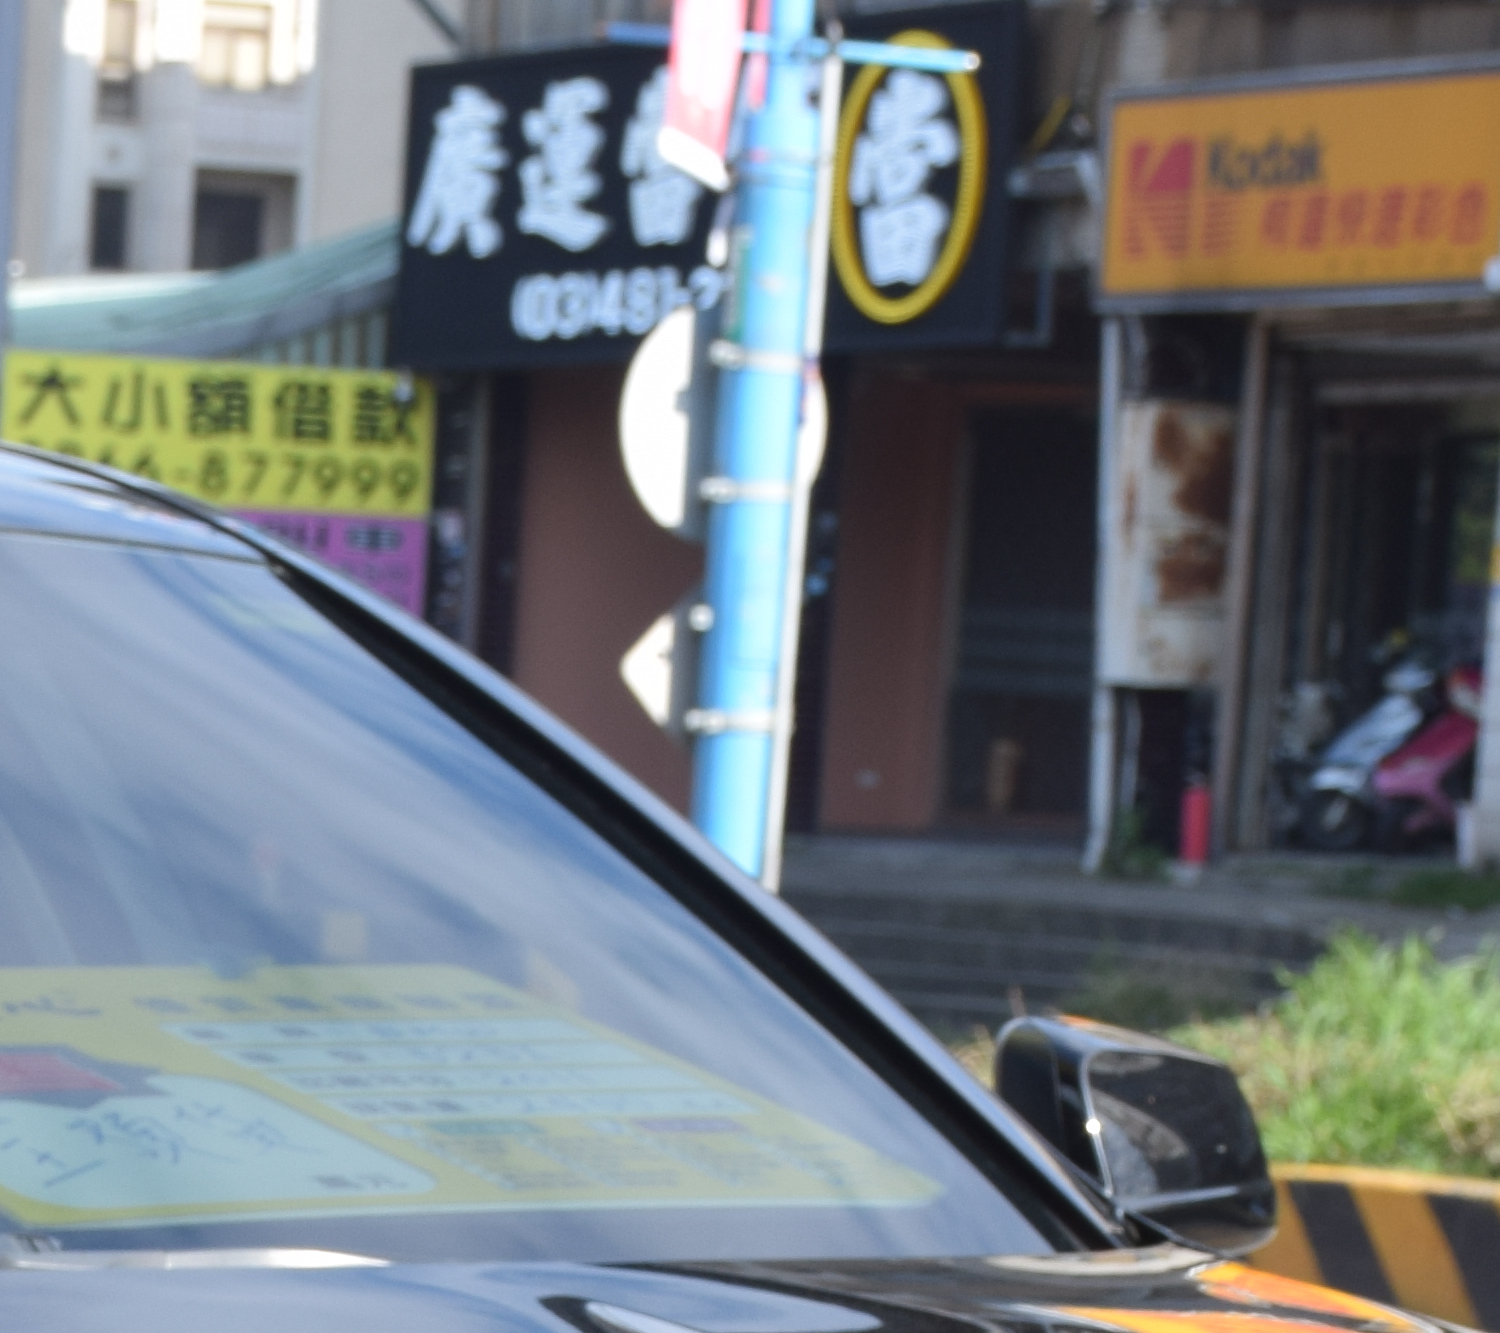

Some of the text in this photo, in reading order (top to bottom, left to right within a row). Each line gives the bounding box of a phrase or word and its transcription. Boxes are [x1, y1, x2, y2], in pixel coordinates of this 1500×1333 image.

[17, 363, 417, 446] 大小額借款
[22, 436, 418, 498] 6-877999
